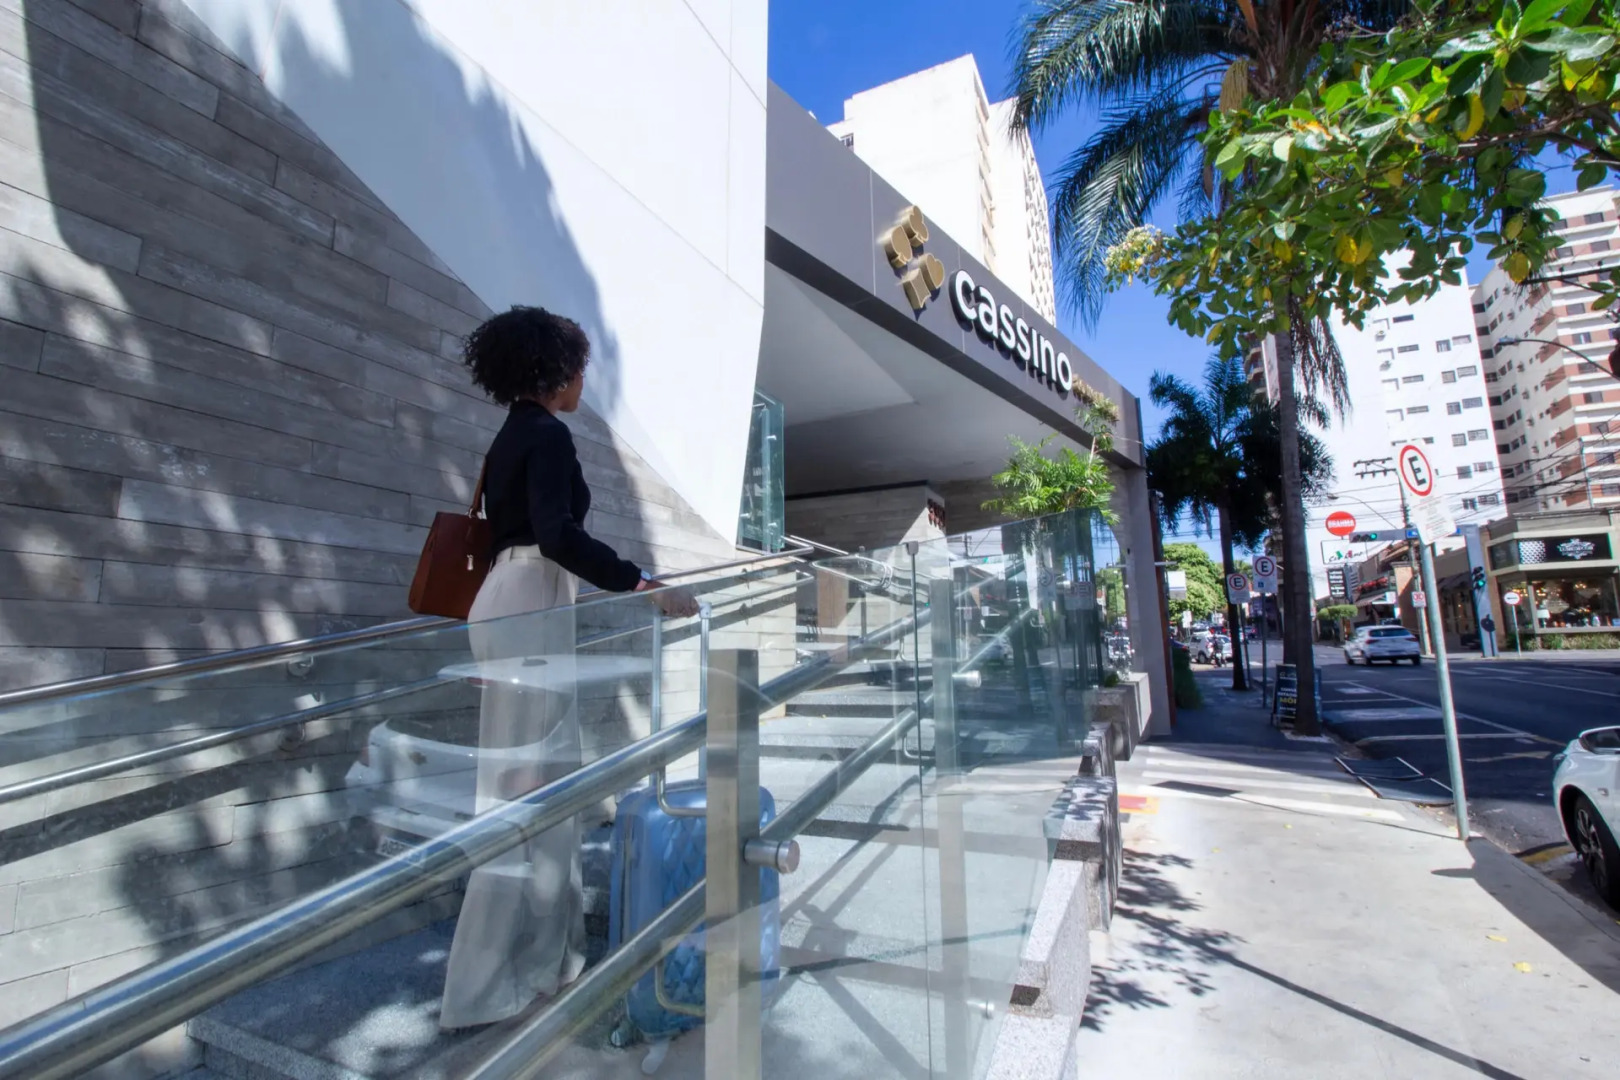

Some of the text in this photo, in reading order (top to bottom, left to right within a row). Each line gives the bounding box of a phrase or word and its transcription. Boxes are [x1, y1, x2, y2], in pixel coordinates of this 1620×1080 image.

[952, 270, 1073, 391] cassino
[1407, 455, 1427, 486] E
[1261, 560, 1269, 573] E
[1233, 577, 1243, 588] E
